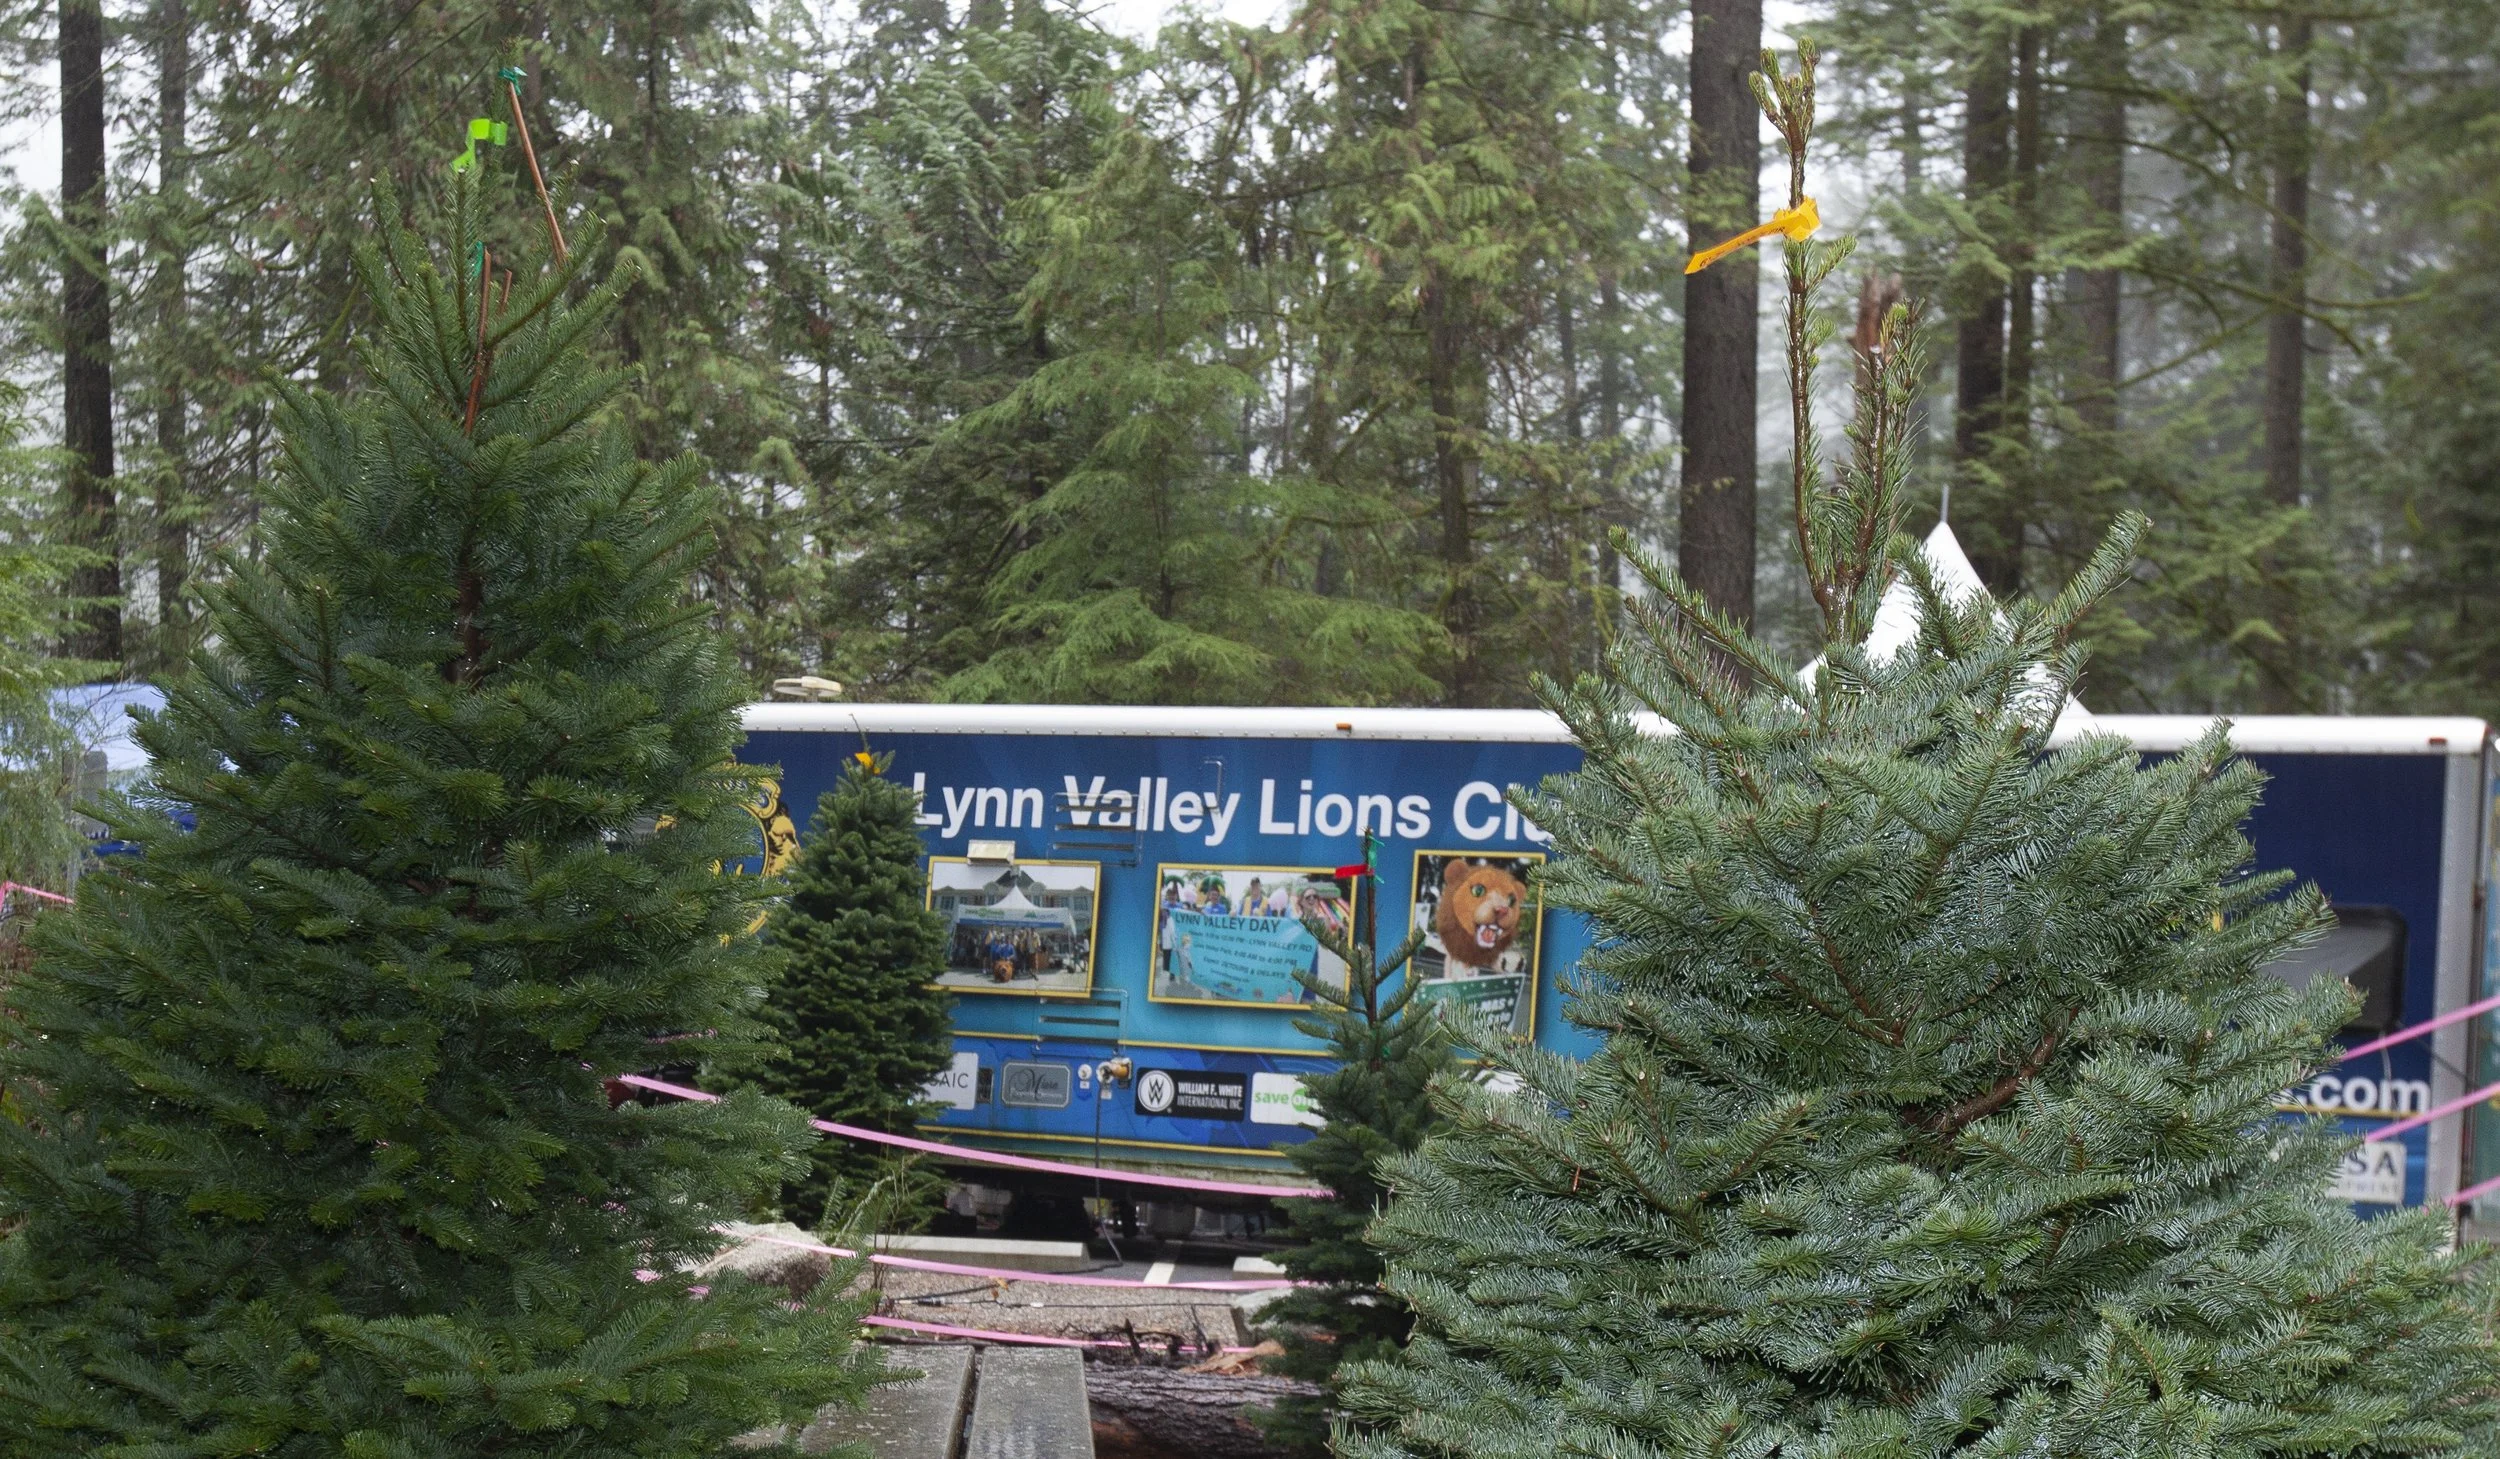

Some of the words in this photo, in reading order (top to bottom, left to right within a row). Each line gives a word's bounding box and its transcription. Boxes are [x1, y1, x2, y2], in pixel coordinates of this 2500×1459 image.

[912, 771, 1044, 839] Lynn
[1063, 775, 1241, 847] Valley
[1258, 777, 1432, 841] Lions
[1174, 912, 1201, 926] LYNN
[1203, 914, 1246, 930] VALLEY
[1249, 918, 1281, 934] DAY
[929, 1070, 969, 1089] AIC
[1177, 1081, 1209, 1096] WILLIAM
[1210, 1083, 1217, 1096] F.
[1218, 1084, 1243, 1098] WHITE
[1253, 1090, 1289, 1105] save
[1177, 1095, 1228, 1110] INTERNATIONAL
[1229, 1099, 1244, 1111] INC.
